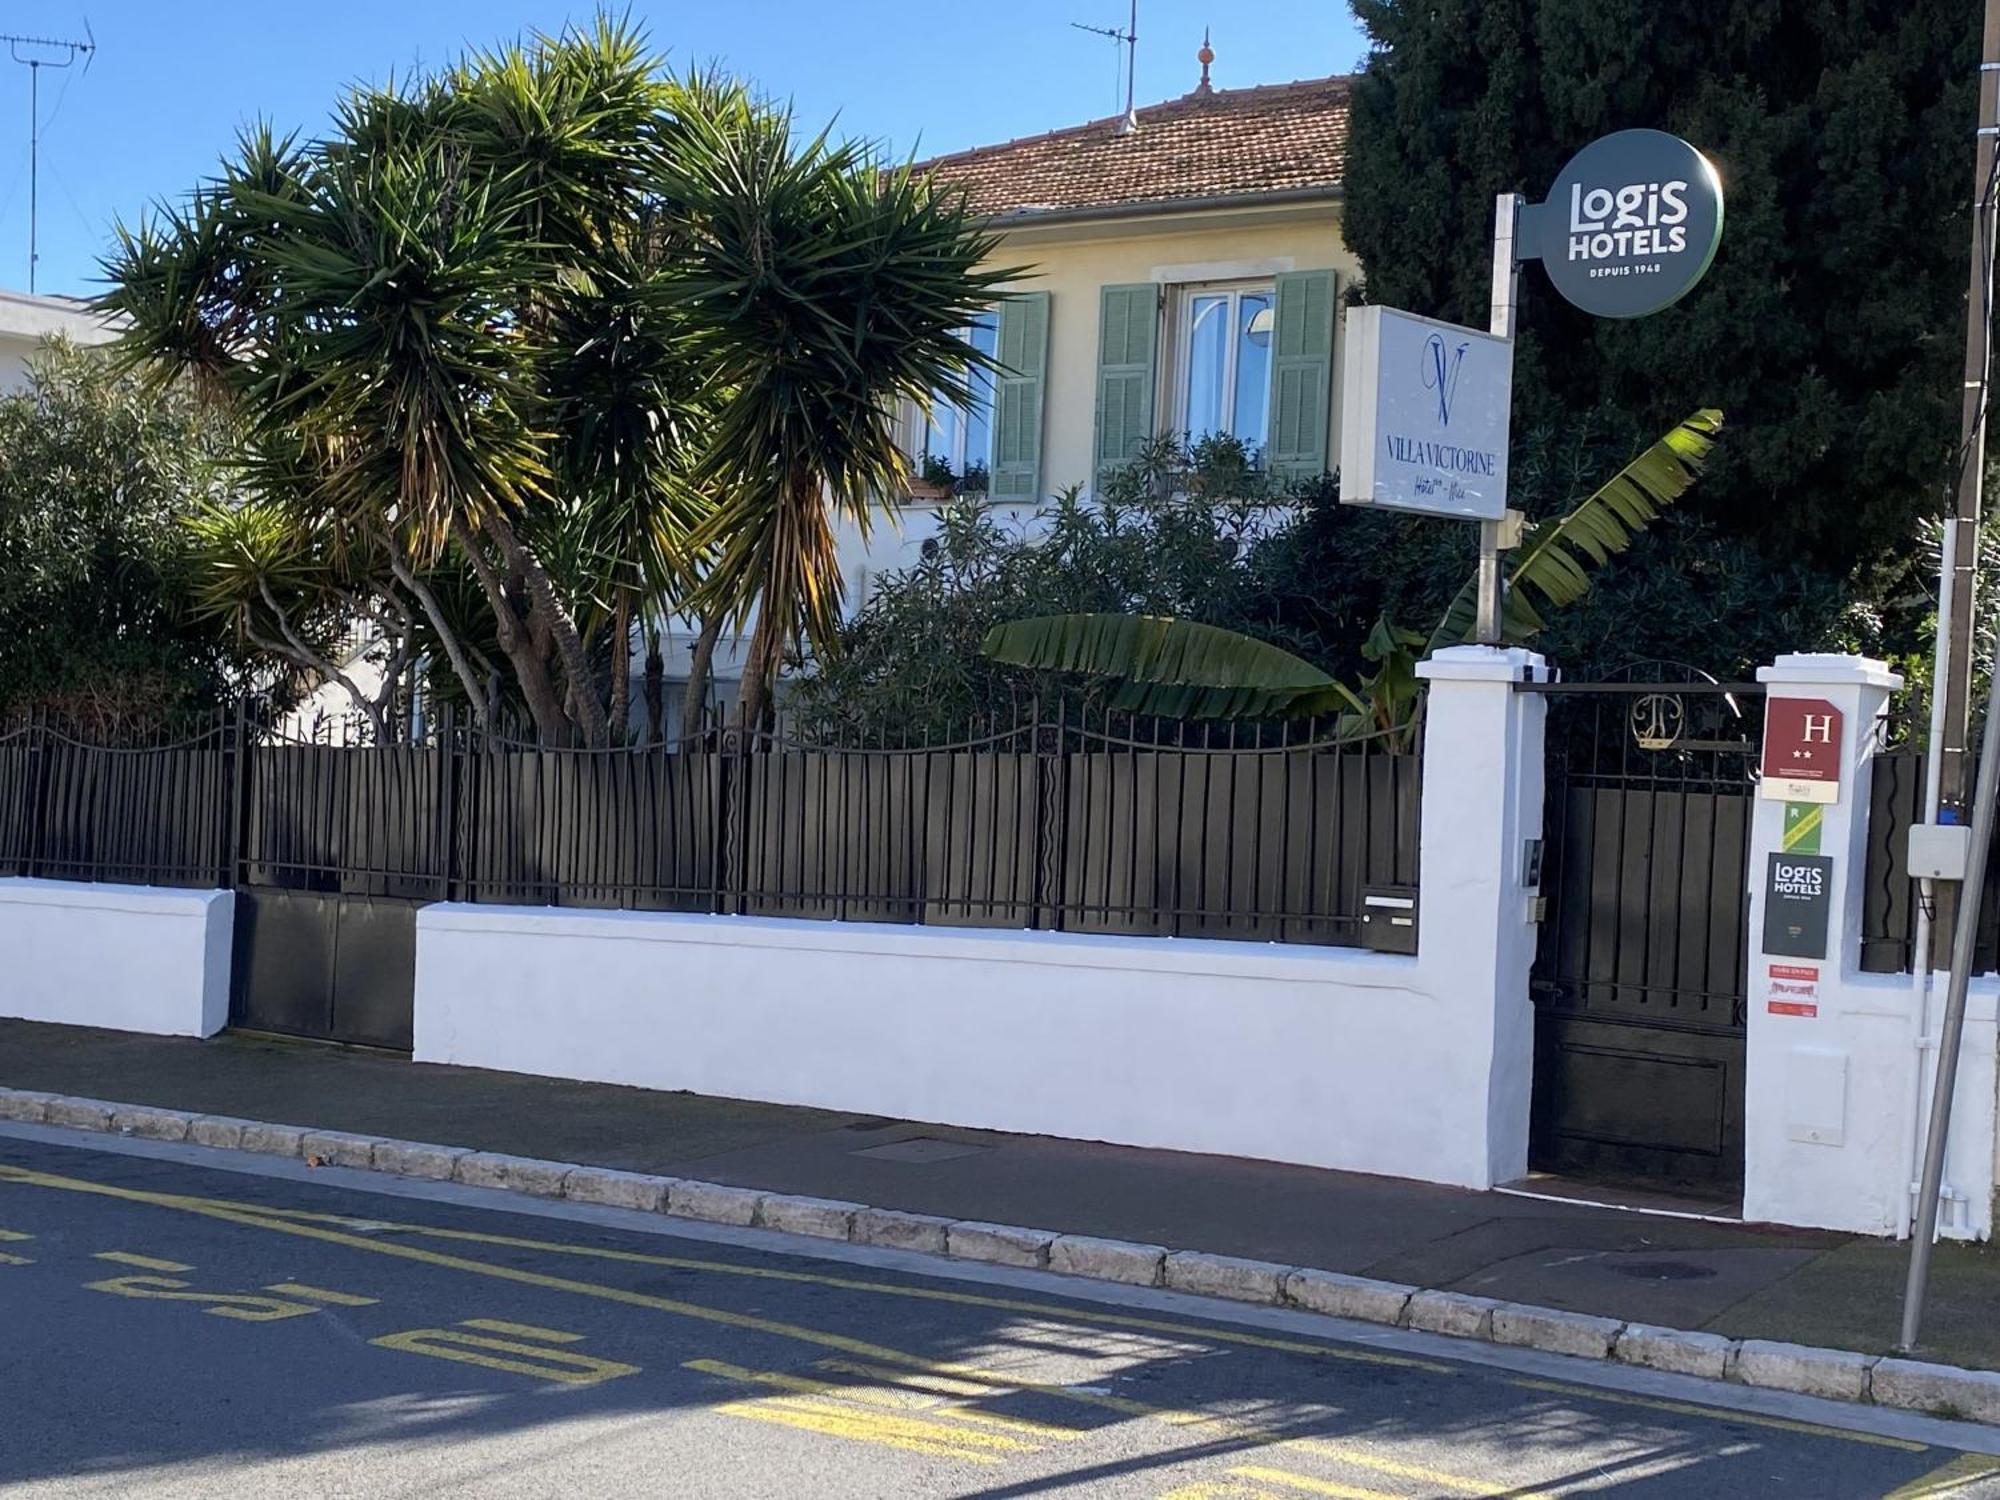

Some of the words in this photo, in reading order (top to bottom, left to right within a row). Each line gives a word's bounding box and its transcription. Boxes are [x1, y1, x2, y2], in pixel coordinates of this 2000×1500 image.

[1568, 226, 1687, 261] HOTELS
[1590, 265, 1630, 278] DEPUIS
[1387, 435, 1425, 466] VILLA
[1425, 442, 1496, 477] VICTORINE
[1802, 713, 1834, 744] H
[1774, 883, 1822, 896] HOTELS
